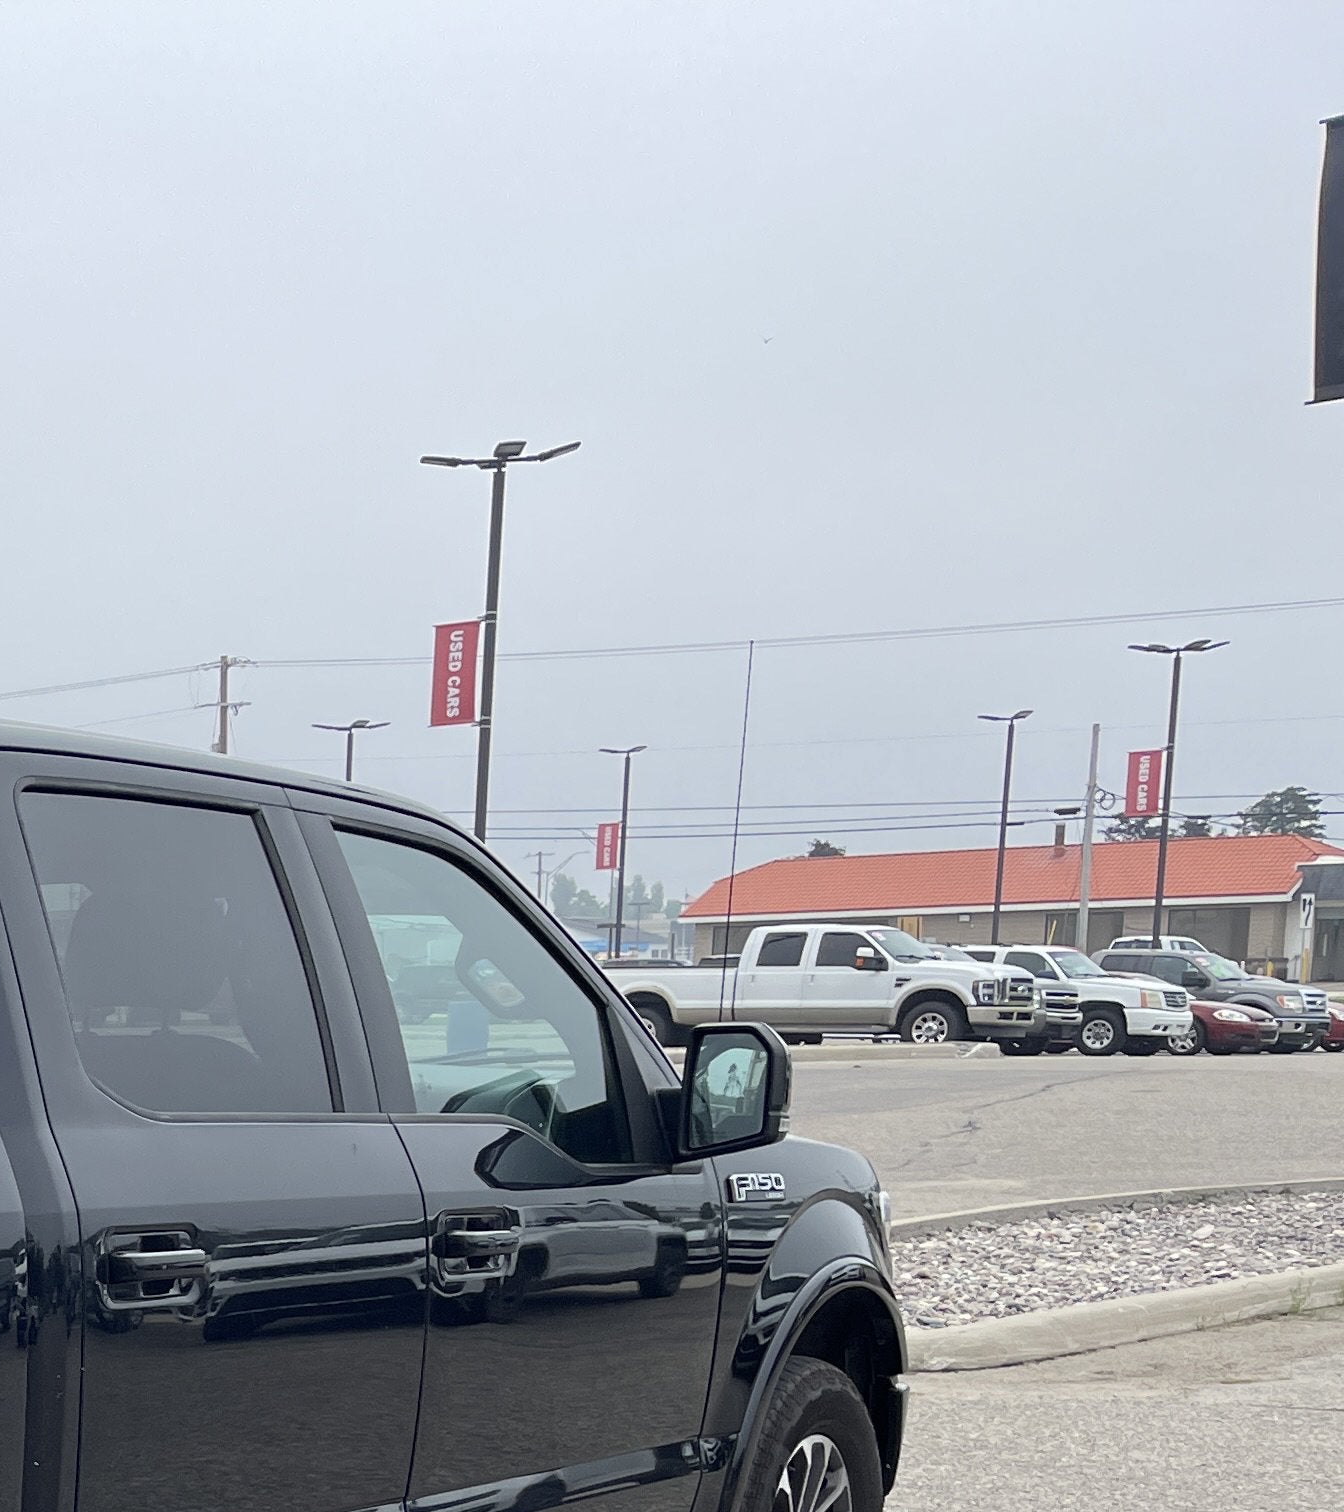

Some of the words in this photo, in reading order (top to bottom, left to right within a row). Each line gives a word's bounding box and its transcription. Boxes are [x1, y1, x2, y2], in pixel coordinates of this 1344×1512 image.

[447, 630, 464, 673] USED
[446, 675, 461, 718] CARS
[1138, 755, 1151, 783] USED
[1136, 784, 1149, 812] CARS
[604, 826, 613, 846] USED
[603, 846, 611, 867] CARS
